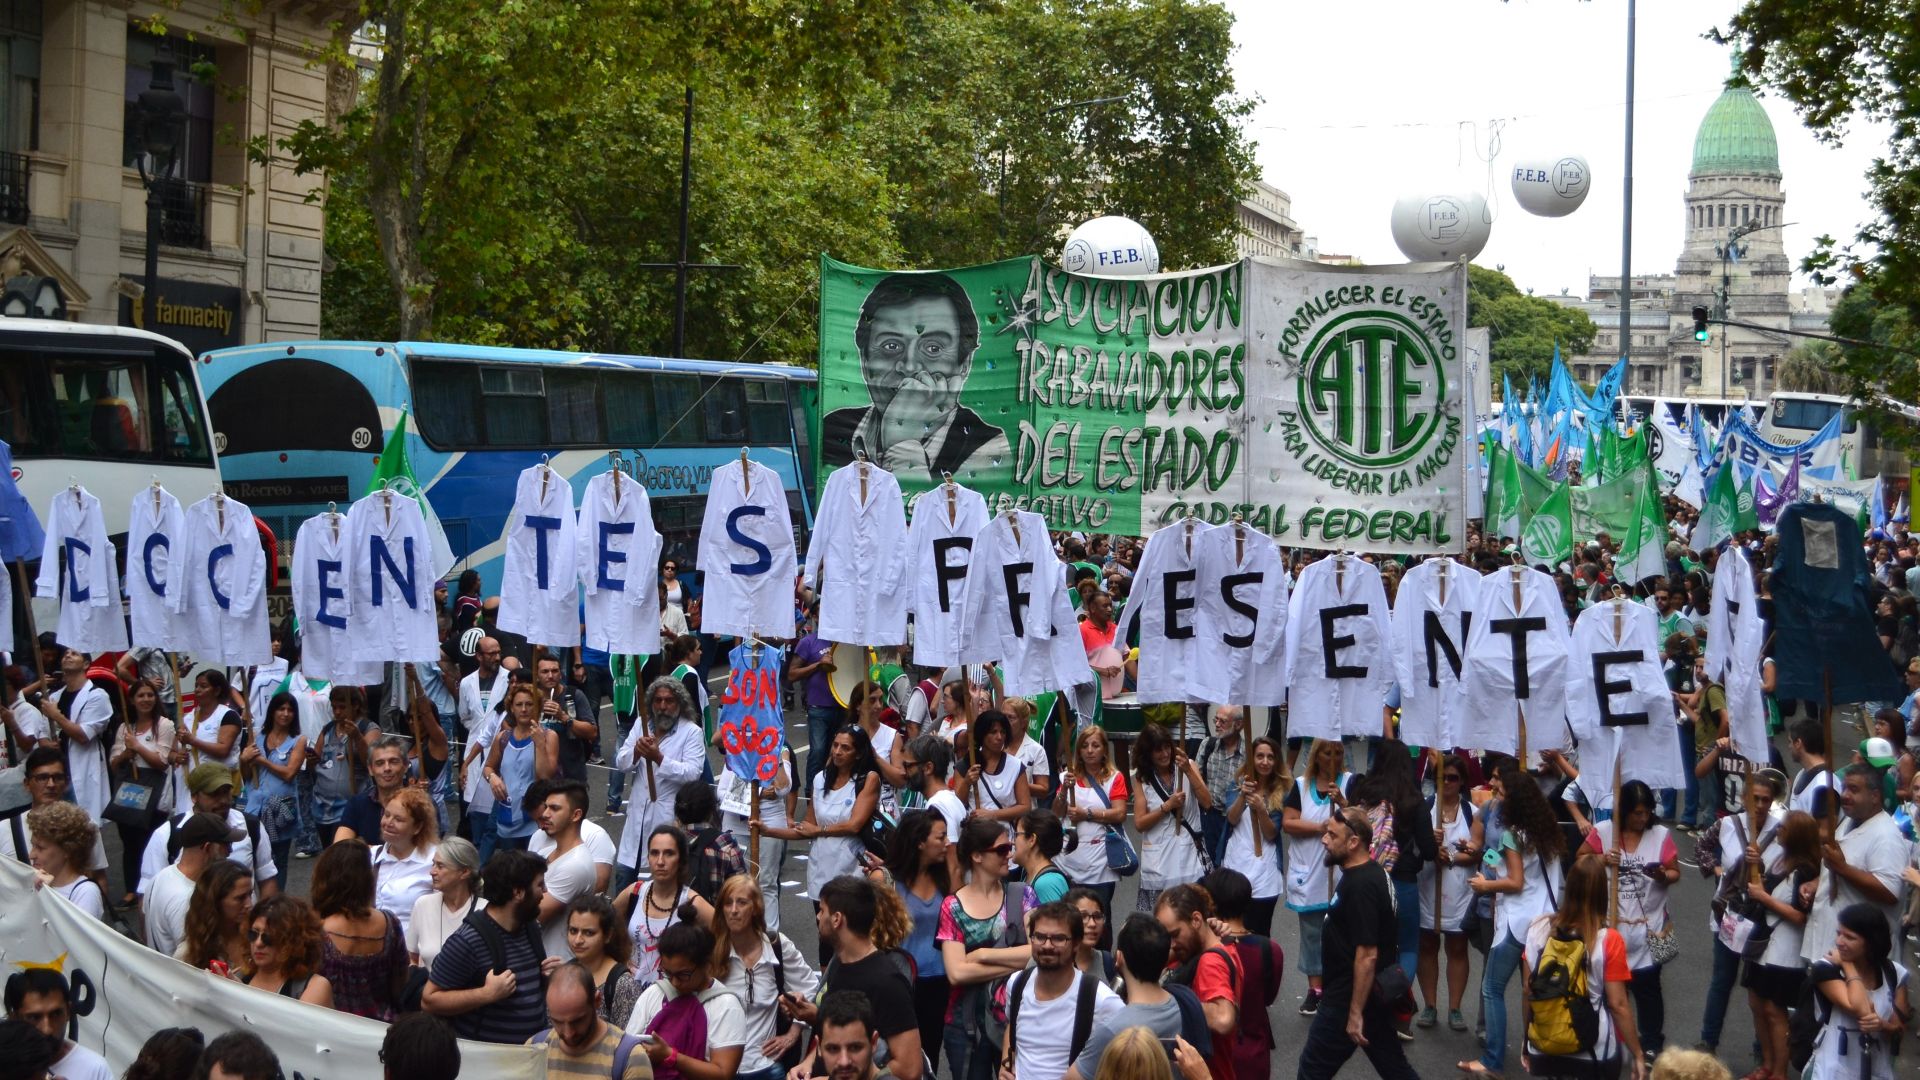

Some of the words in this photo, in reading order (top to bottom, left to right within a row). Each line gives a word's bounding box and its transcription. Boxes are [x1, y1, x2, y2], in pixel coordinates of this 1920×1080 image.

[1516, 168, 1549, 183] F.E.B.
[1098, 248, 1142, 266] F.E.B.
[156, 296, 233, 335] farmacity
[1020, 255, 1244, 338] ASOCIACION
[1278, 285, 1376, 358] FORTALECER
[1381, 286, 1405, 306] EL
[1408, 296, 1457, 361] ESTADO
[1015, 338, 1246, 413] TRABAJADORES
[1310, 323, 1428, 455] ATE
[354, 431, 370, 446] 90
[1014, 419, 1085, 489] DEL
[1096, 425, 1240, 494] ESTADO
[1278, 410, 1309, 459] PARA
[1302, 453, 1384, 496] LIBERAR
[1388, 469, 1413, 497] LA
[1416, 415, 1461, 487] NACION
[241, 483, 292, 498] Recreo
[310, 484, 347, 495] VIAJES
[986, 491, 1113, 528] IRECTIVO
[1302, 506, 1451, 545] FEDERAL
[721, 668, 777, 710] SON
